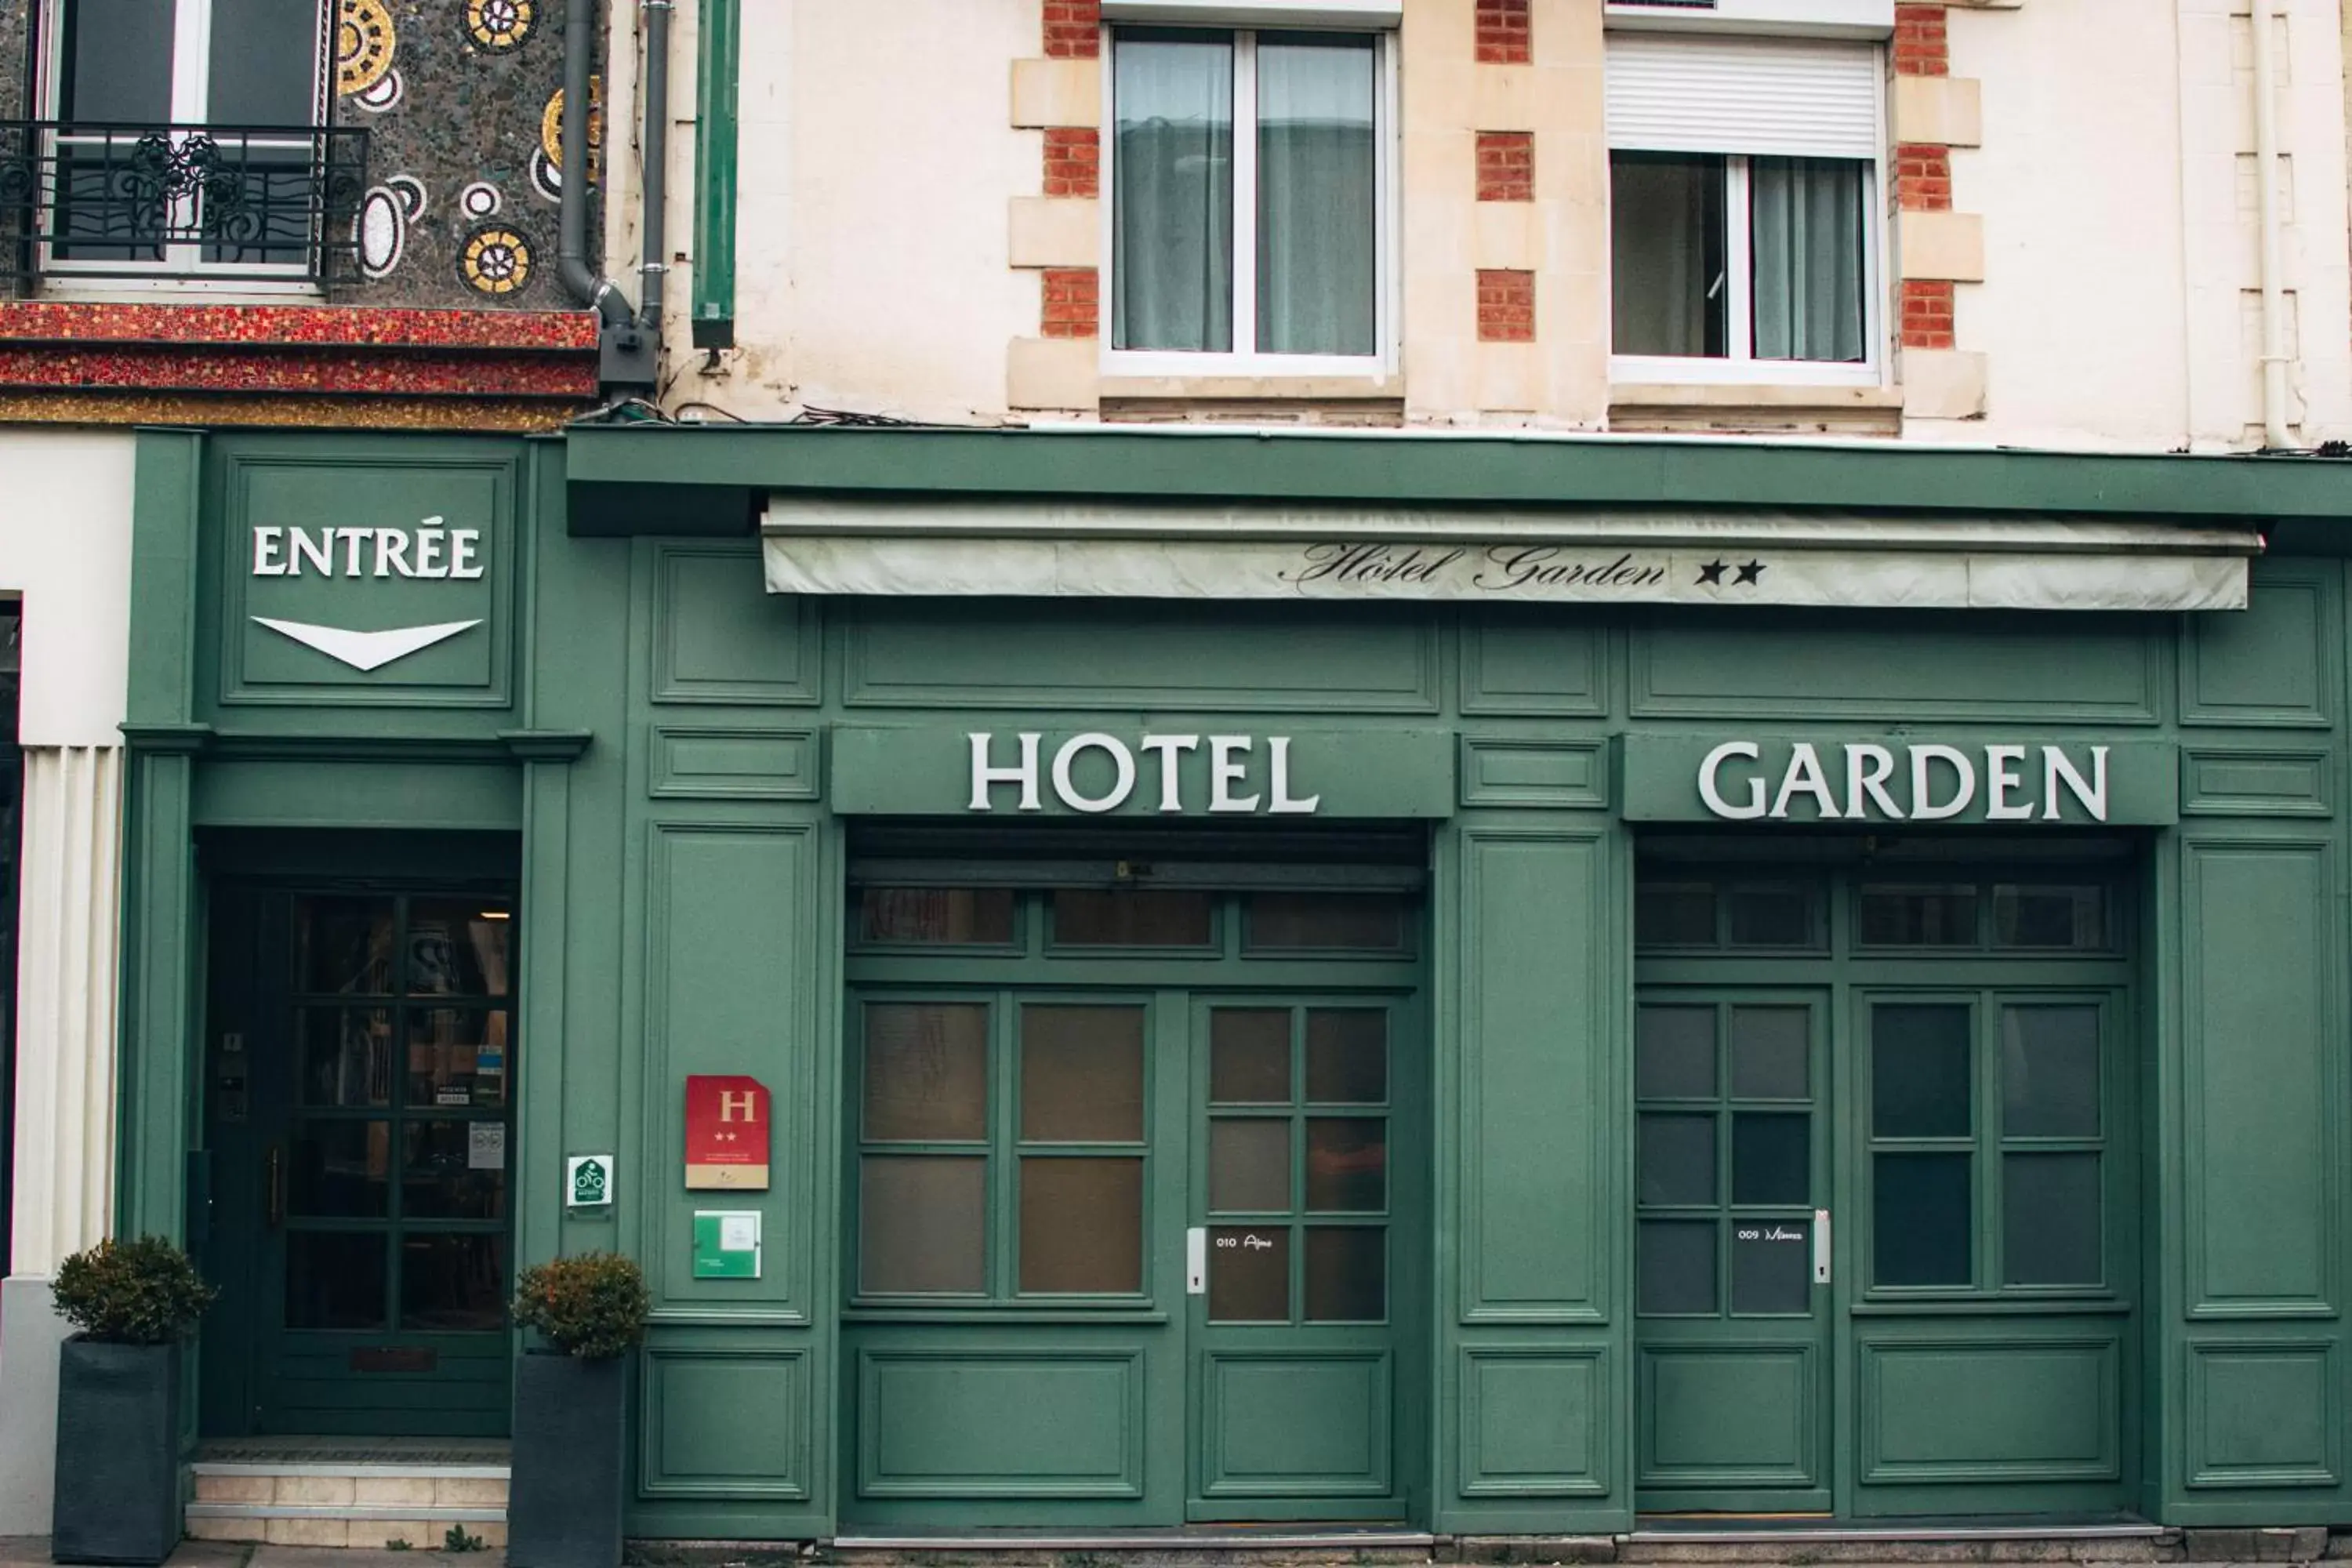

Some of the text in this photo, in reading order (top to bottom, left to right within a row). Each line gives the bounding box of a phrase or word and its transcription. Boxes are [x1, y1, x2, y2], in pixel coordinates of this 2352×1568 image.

[252, 515, 484, 579] ENTRÉE
[1277, 543, 1665, 595] Hôtel Garden
[967, 732, 1320, 813] HOTEL
[1698, 741, 2111, 821] GARDEN
[720, 1091, 758, 1123] H
[1216, 1238, 1236, 1248] 010
